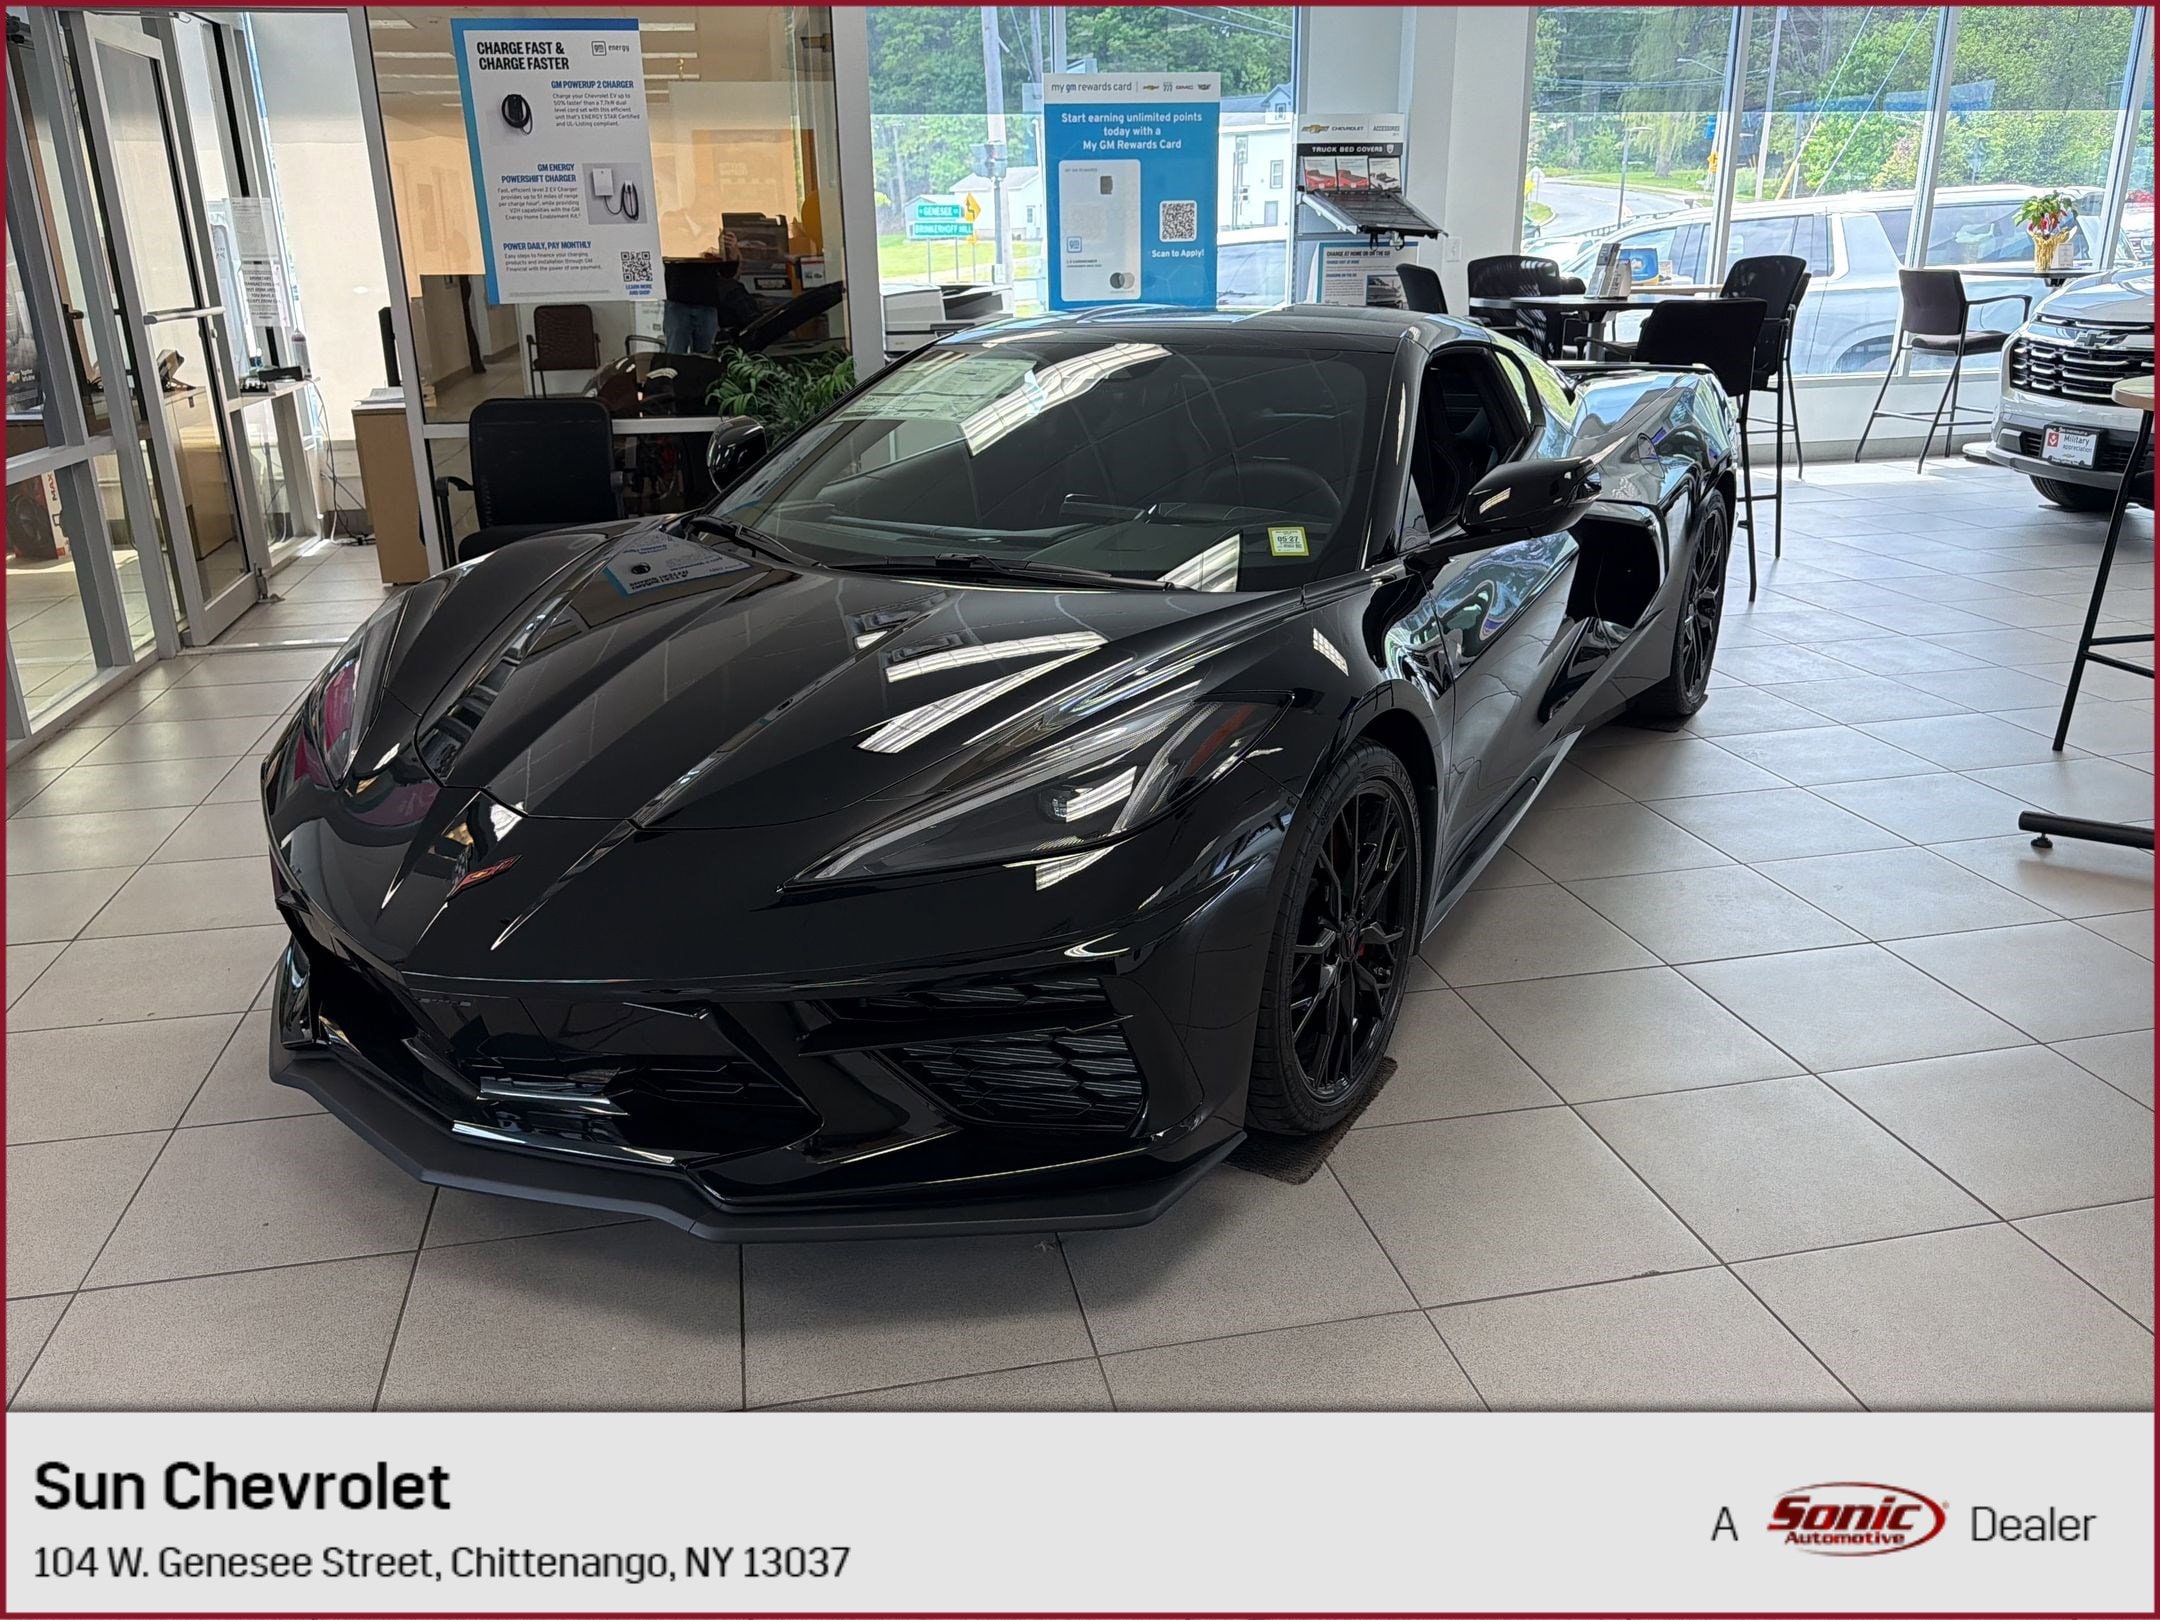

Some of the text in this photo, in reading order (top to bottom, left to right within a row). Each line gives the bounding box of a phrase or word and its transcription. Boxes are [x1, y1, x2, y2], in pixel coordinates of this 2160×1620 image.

[477, 41, 565, 55] CHARGE FAST &
[608, 44, 630, 52] energy
[479, 57, 569, 70] CHARGE FASTER
[551, 80, 634, 88] GM POWERUP 2 CHARGER
[1051, 82, 1132, 93] my gm rewards card
[1061, 112, 1202, 124] Start earning unlimited points
[1104, 126, 1161, 138] today with a
[1083, 139, 1182, 152] My GM Rewards Card
[549, 163, 574, 171] ENERGY
[501, 175, 543, 183] POWERSHIFT
[503, 241, 591, 251] POWER DAILY, PAY MONTHLY
[1152, 249, 1170, 258] Scan
[1181, 249, 1204, 258] Apply!
[2064, 435, 2090, 446] Military
